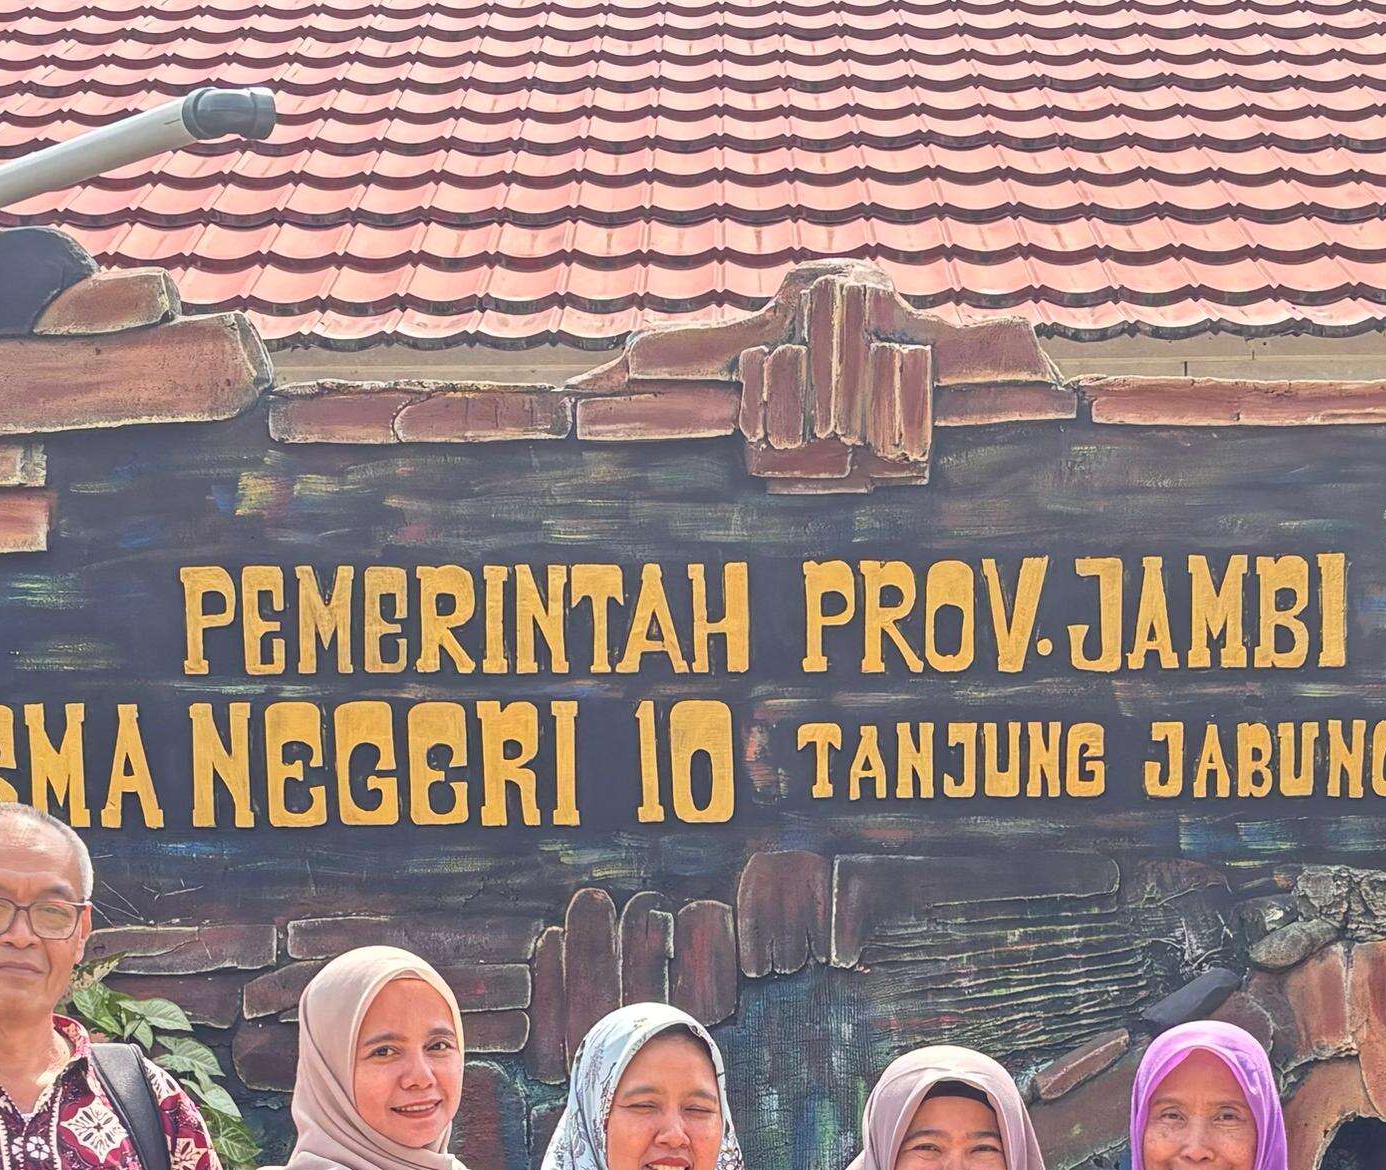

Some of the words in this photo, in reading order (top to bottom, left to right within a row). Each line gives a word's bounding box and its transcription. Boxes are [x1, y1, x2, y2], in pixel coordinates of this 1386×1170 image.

[179, 561, 750, 675] PEMERINTAH
[189, 700, 580, 829] NEGERI
[636, 699, 735, 824] 10
[797, 721, 1106, 799] TANJUNG
